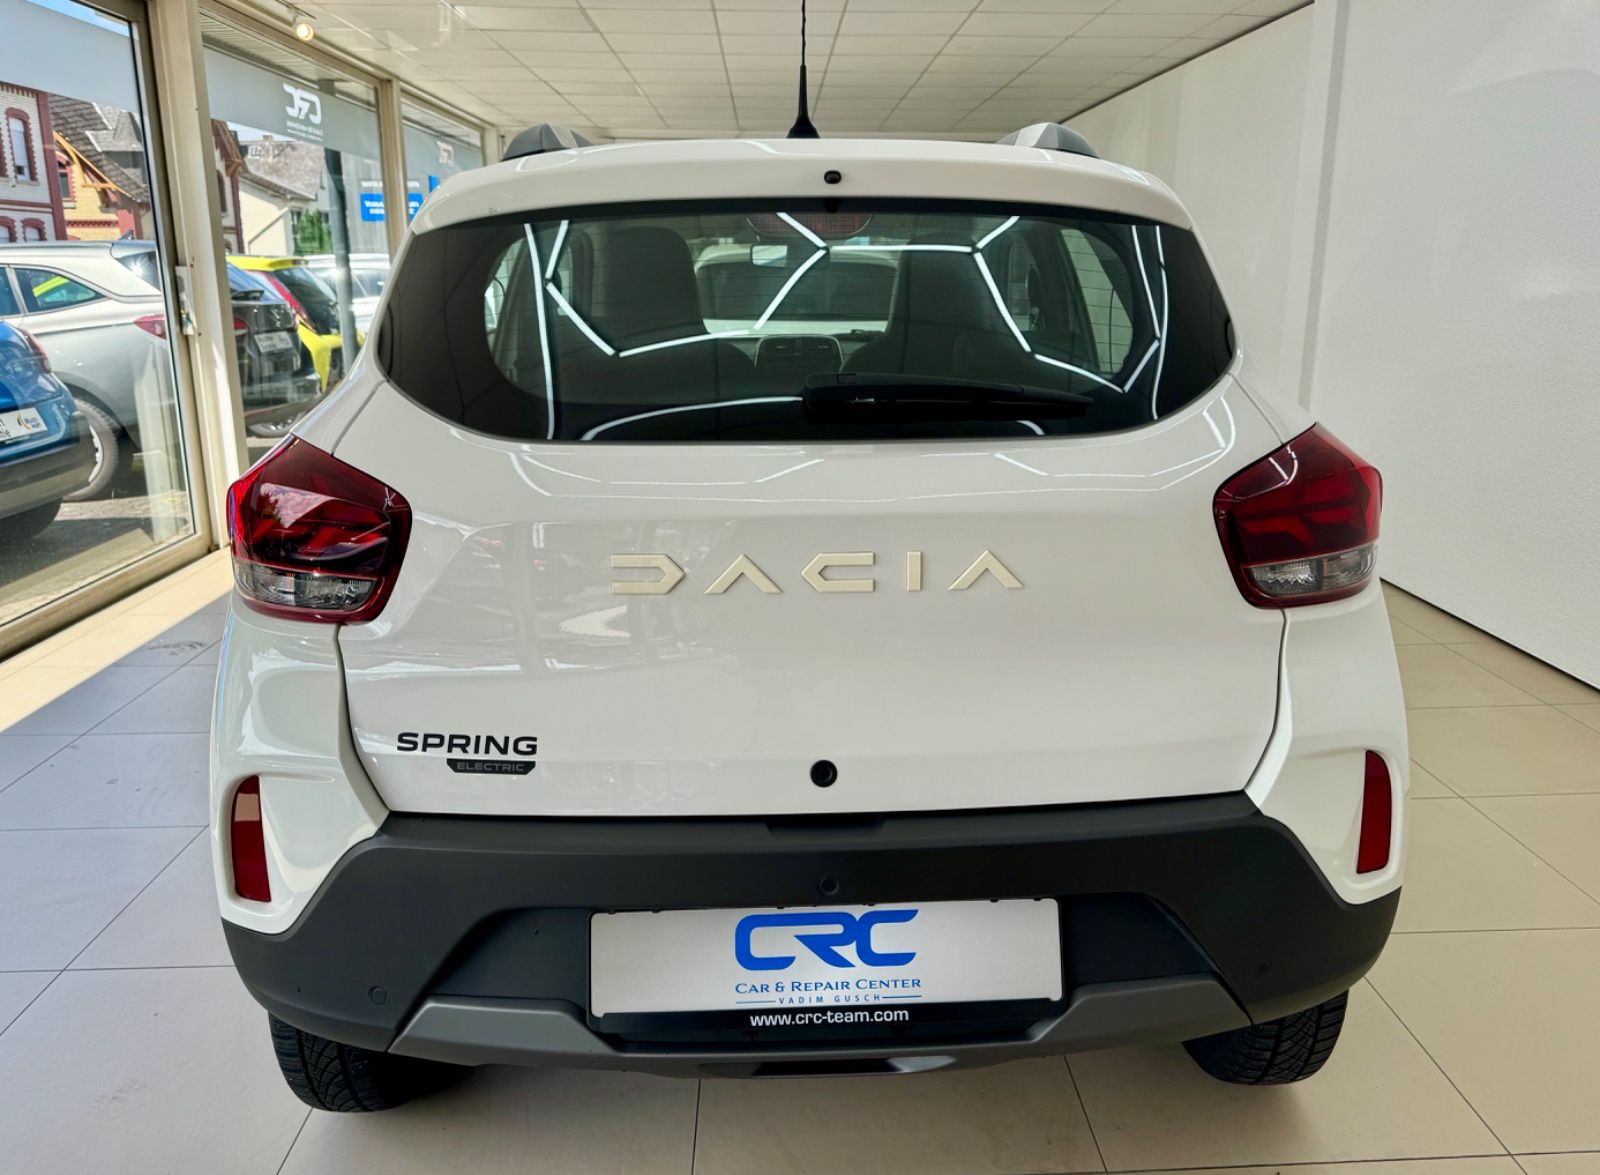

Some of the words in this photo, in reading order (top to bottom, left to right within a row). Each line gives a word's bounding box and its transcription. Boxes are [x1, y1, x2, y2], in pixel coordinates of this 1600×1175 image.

[609, 549, 1024, 596] DACIA
[397, 732, 538, 757] SPRING
[456, 762, 526, 773] ELECTRIC
[735, 909, 919, 971] CRC
[774, 982, 786, 993] &
[778, 996, 825, 1005] VADIM
[834, 994, 882, 1004] GUSCH
[750, 1010, 910, 1027] www.crc-team.com
